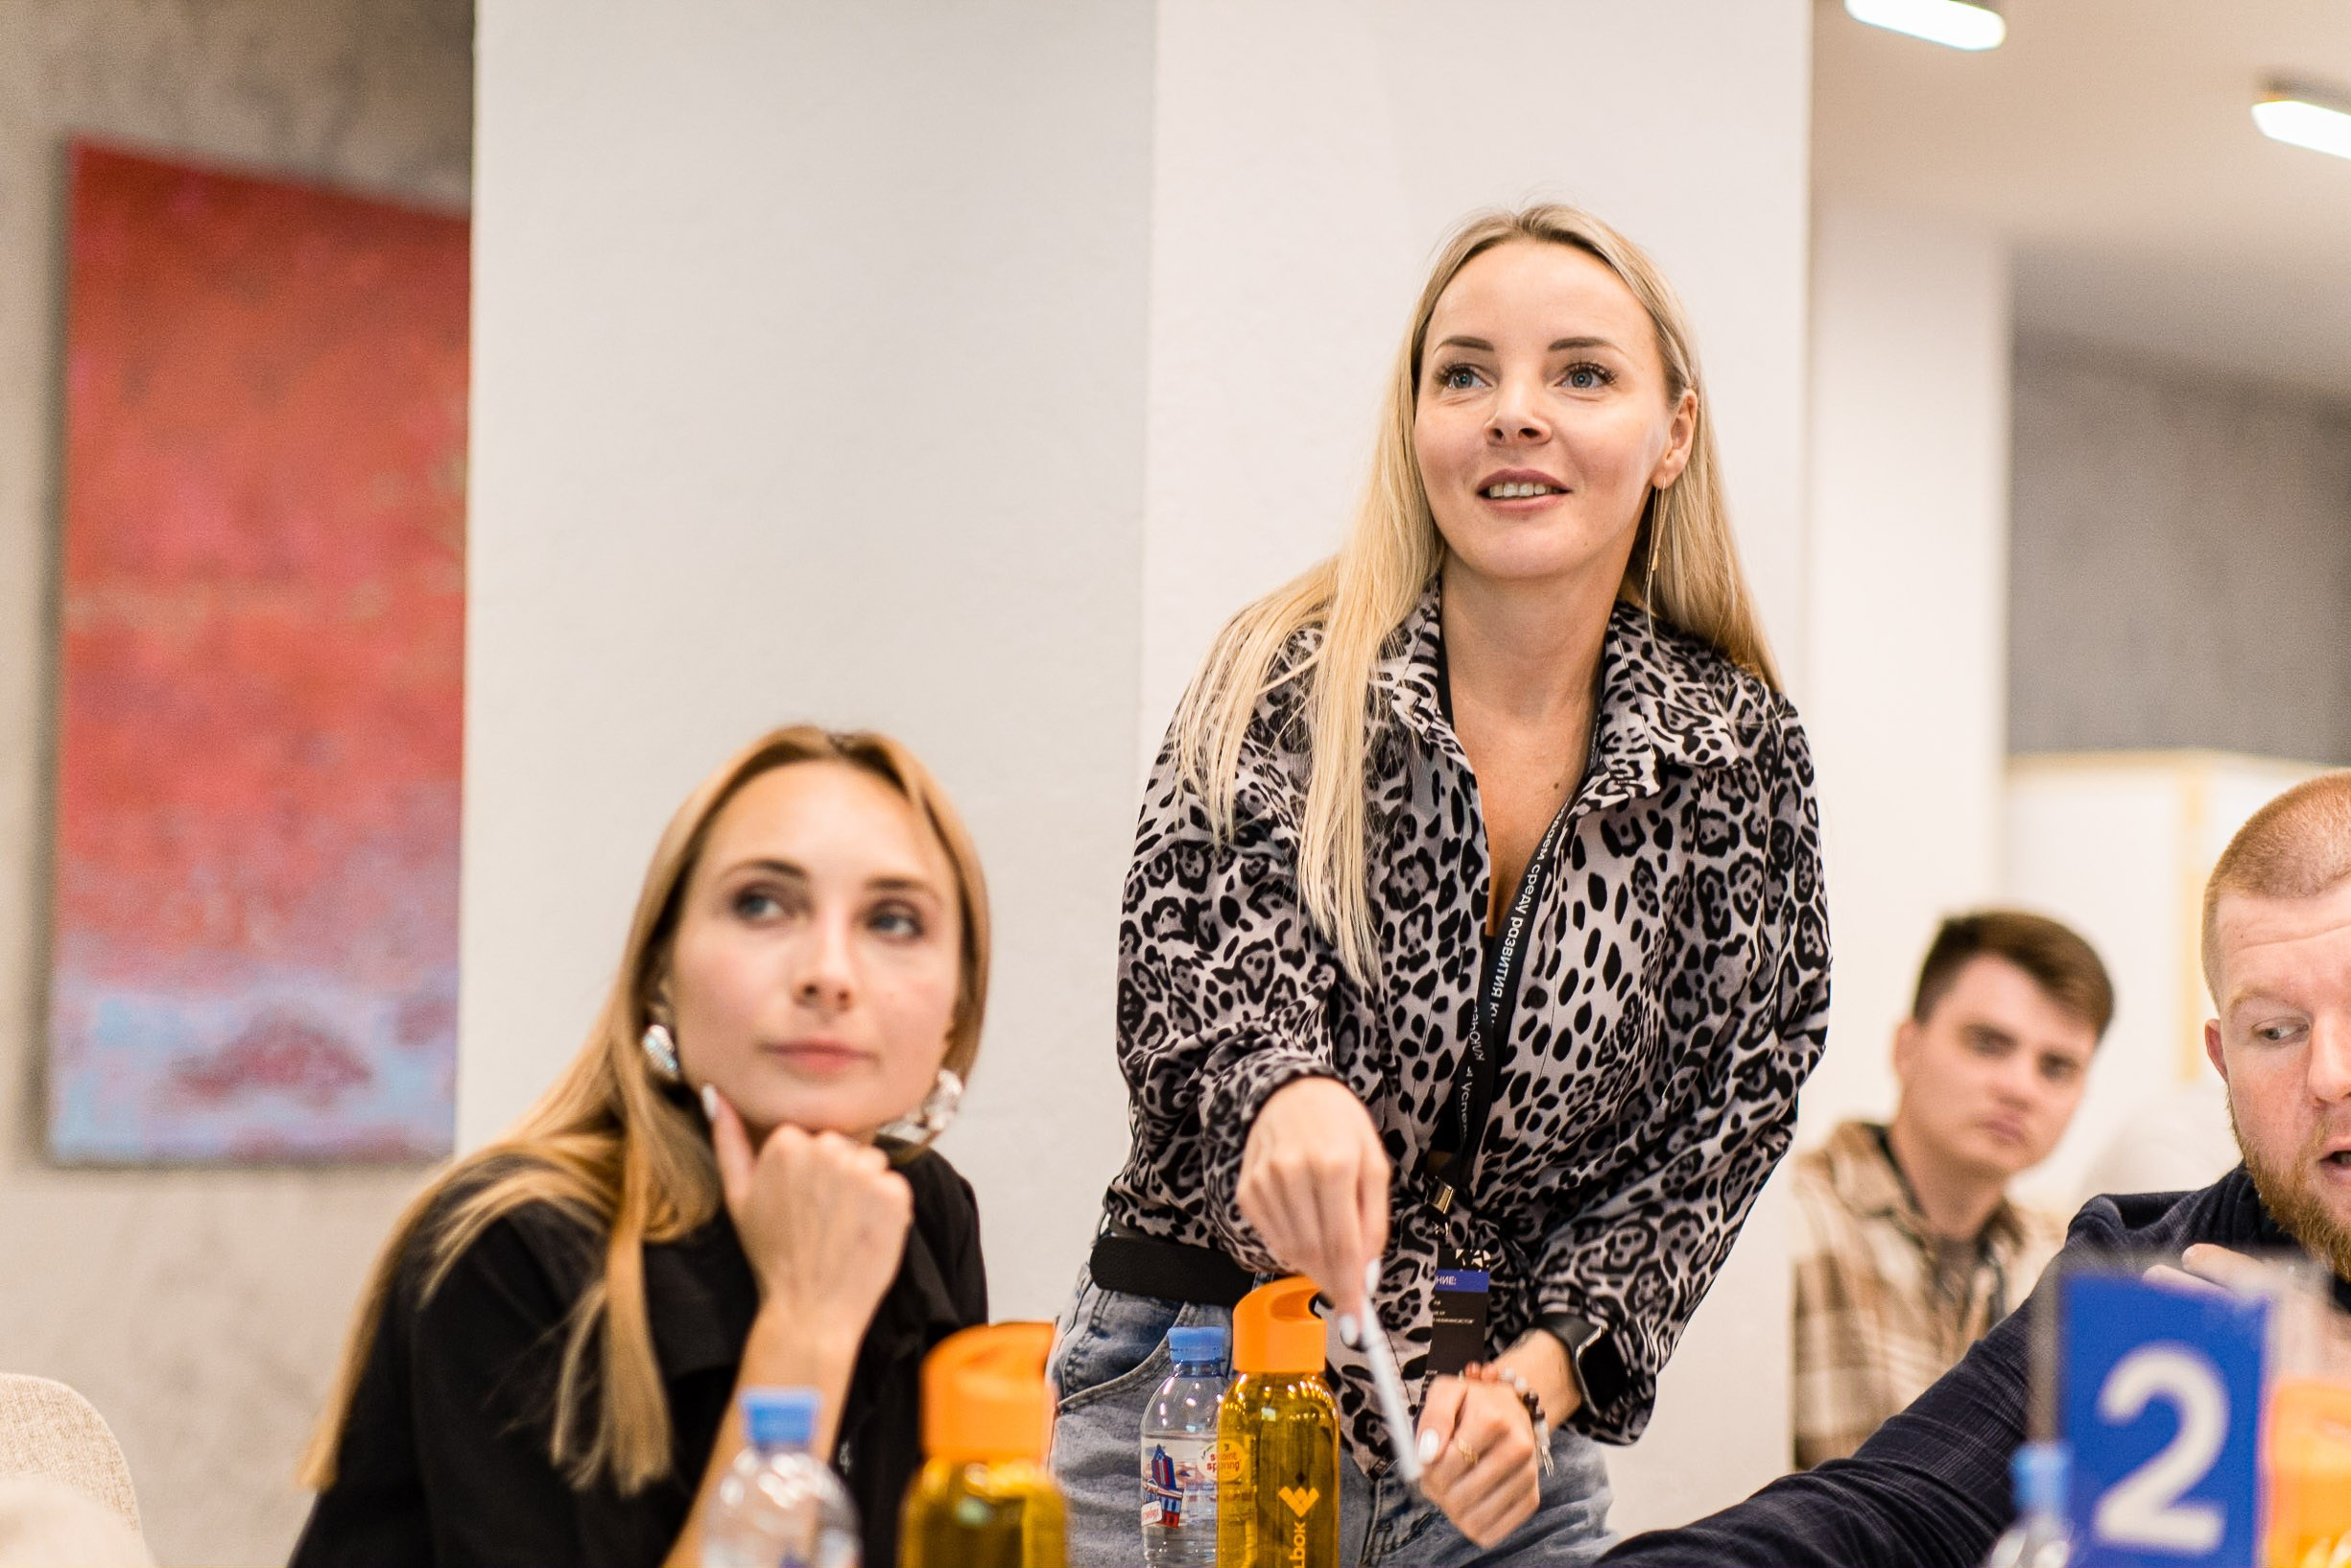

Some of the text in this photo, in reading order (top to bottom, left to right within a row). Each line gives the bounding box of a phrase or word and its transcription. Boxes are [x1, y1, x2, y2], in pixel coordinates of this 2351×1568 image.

[1515, 864, 1541, 915] среду
[1491, 916, 1524, 998] развития
[2097, 1343, 2228, 1547] 2
